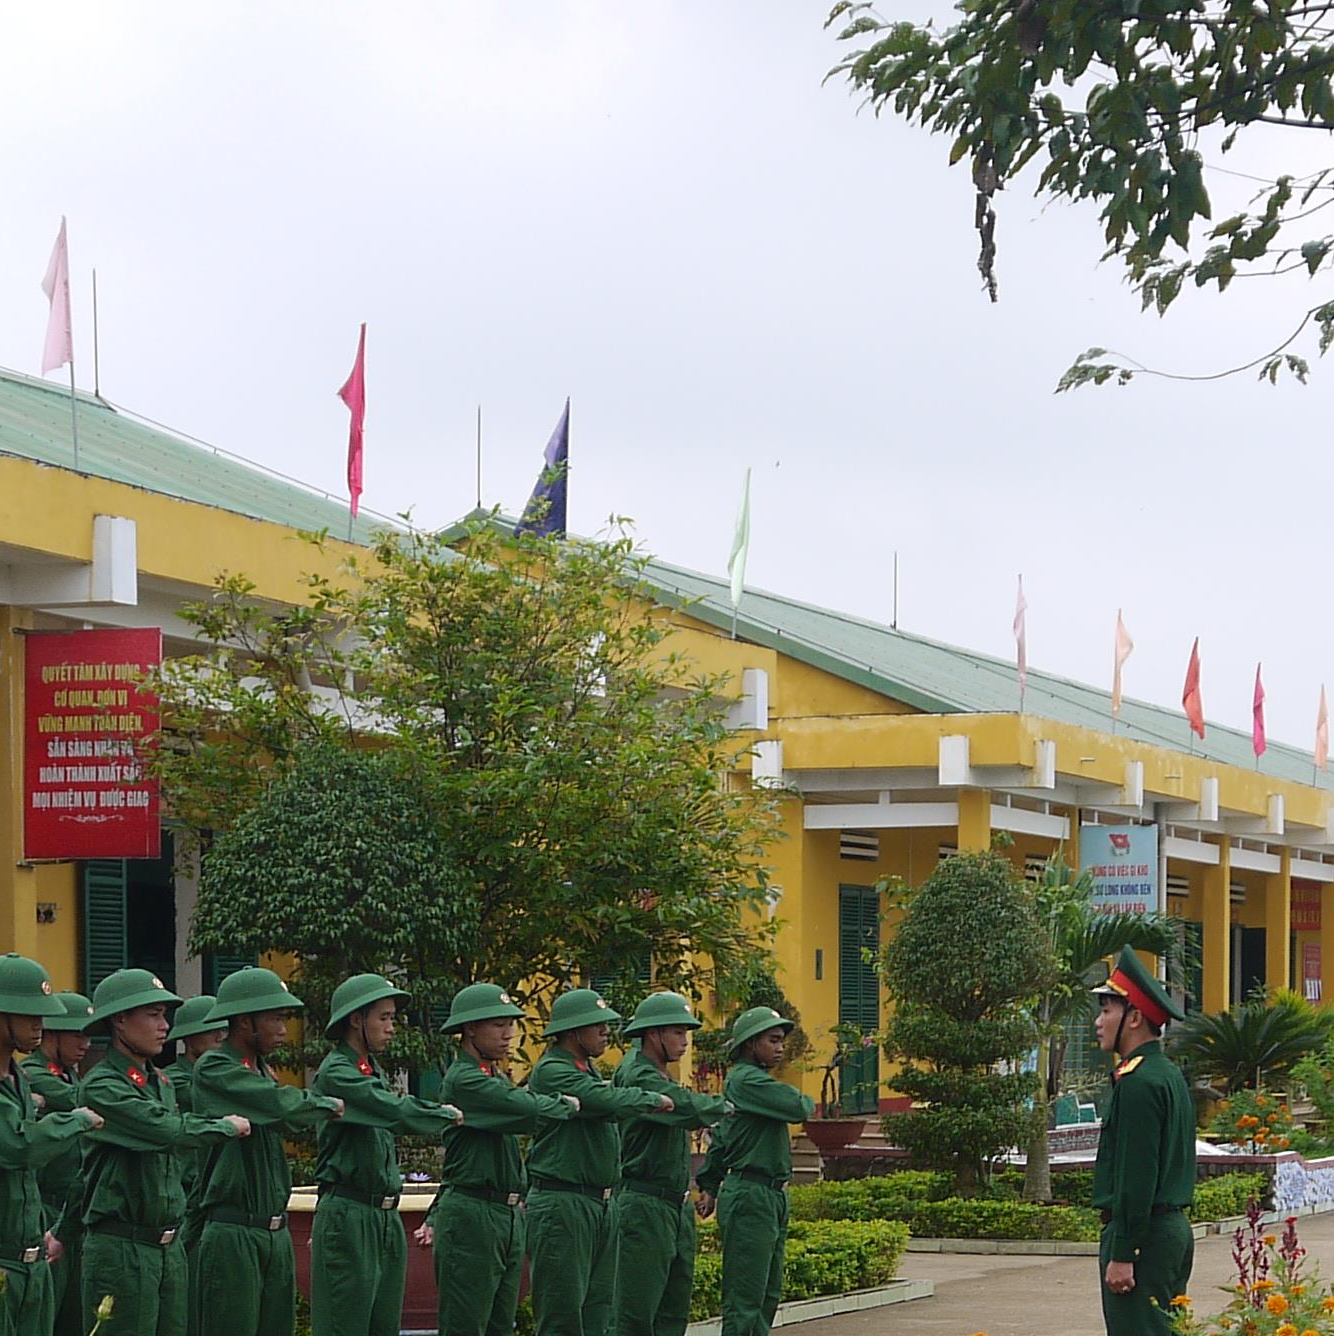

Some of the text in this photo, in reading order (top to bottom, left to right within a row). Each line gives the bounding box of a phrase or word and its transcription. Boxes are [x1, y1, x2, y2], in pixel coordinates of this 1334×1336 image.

[42, 661, 71, 684] QUYẾT
[74, 661, 93, 681] TÂM
[94, 661, 113, 681] XÂY
[54, 689, 68, 707] CƠ
[118, 690, 128, 709] VỊ
[38, 713, 63, 733] VỮNG
[65, 715, 92, 736] MẠNH
[48, 736, 66, 758] SẴN
[68, 737, 92, 758] SÀNG
[39, 763, 65, 783] HOÀN
[66, 763, 96, 783] THÀNH
[98, 761, 121, 782] XUẤT
[32, 792, 50, 811] MỌI
[52, 789, 82, 811] NHIỆM
[84, 791, 96, 810] VỤ
[100, 788, 125, 810] ĐƯỢC
